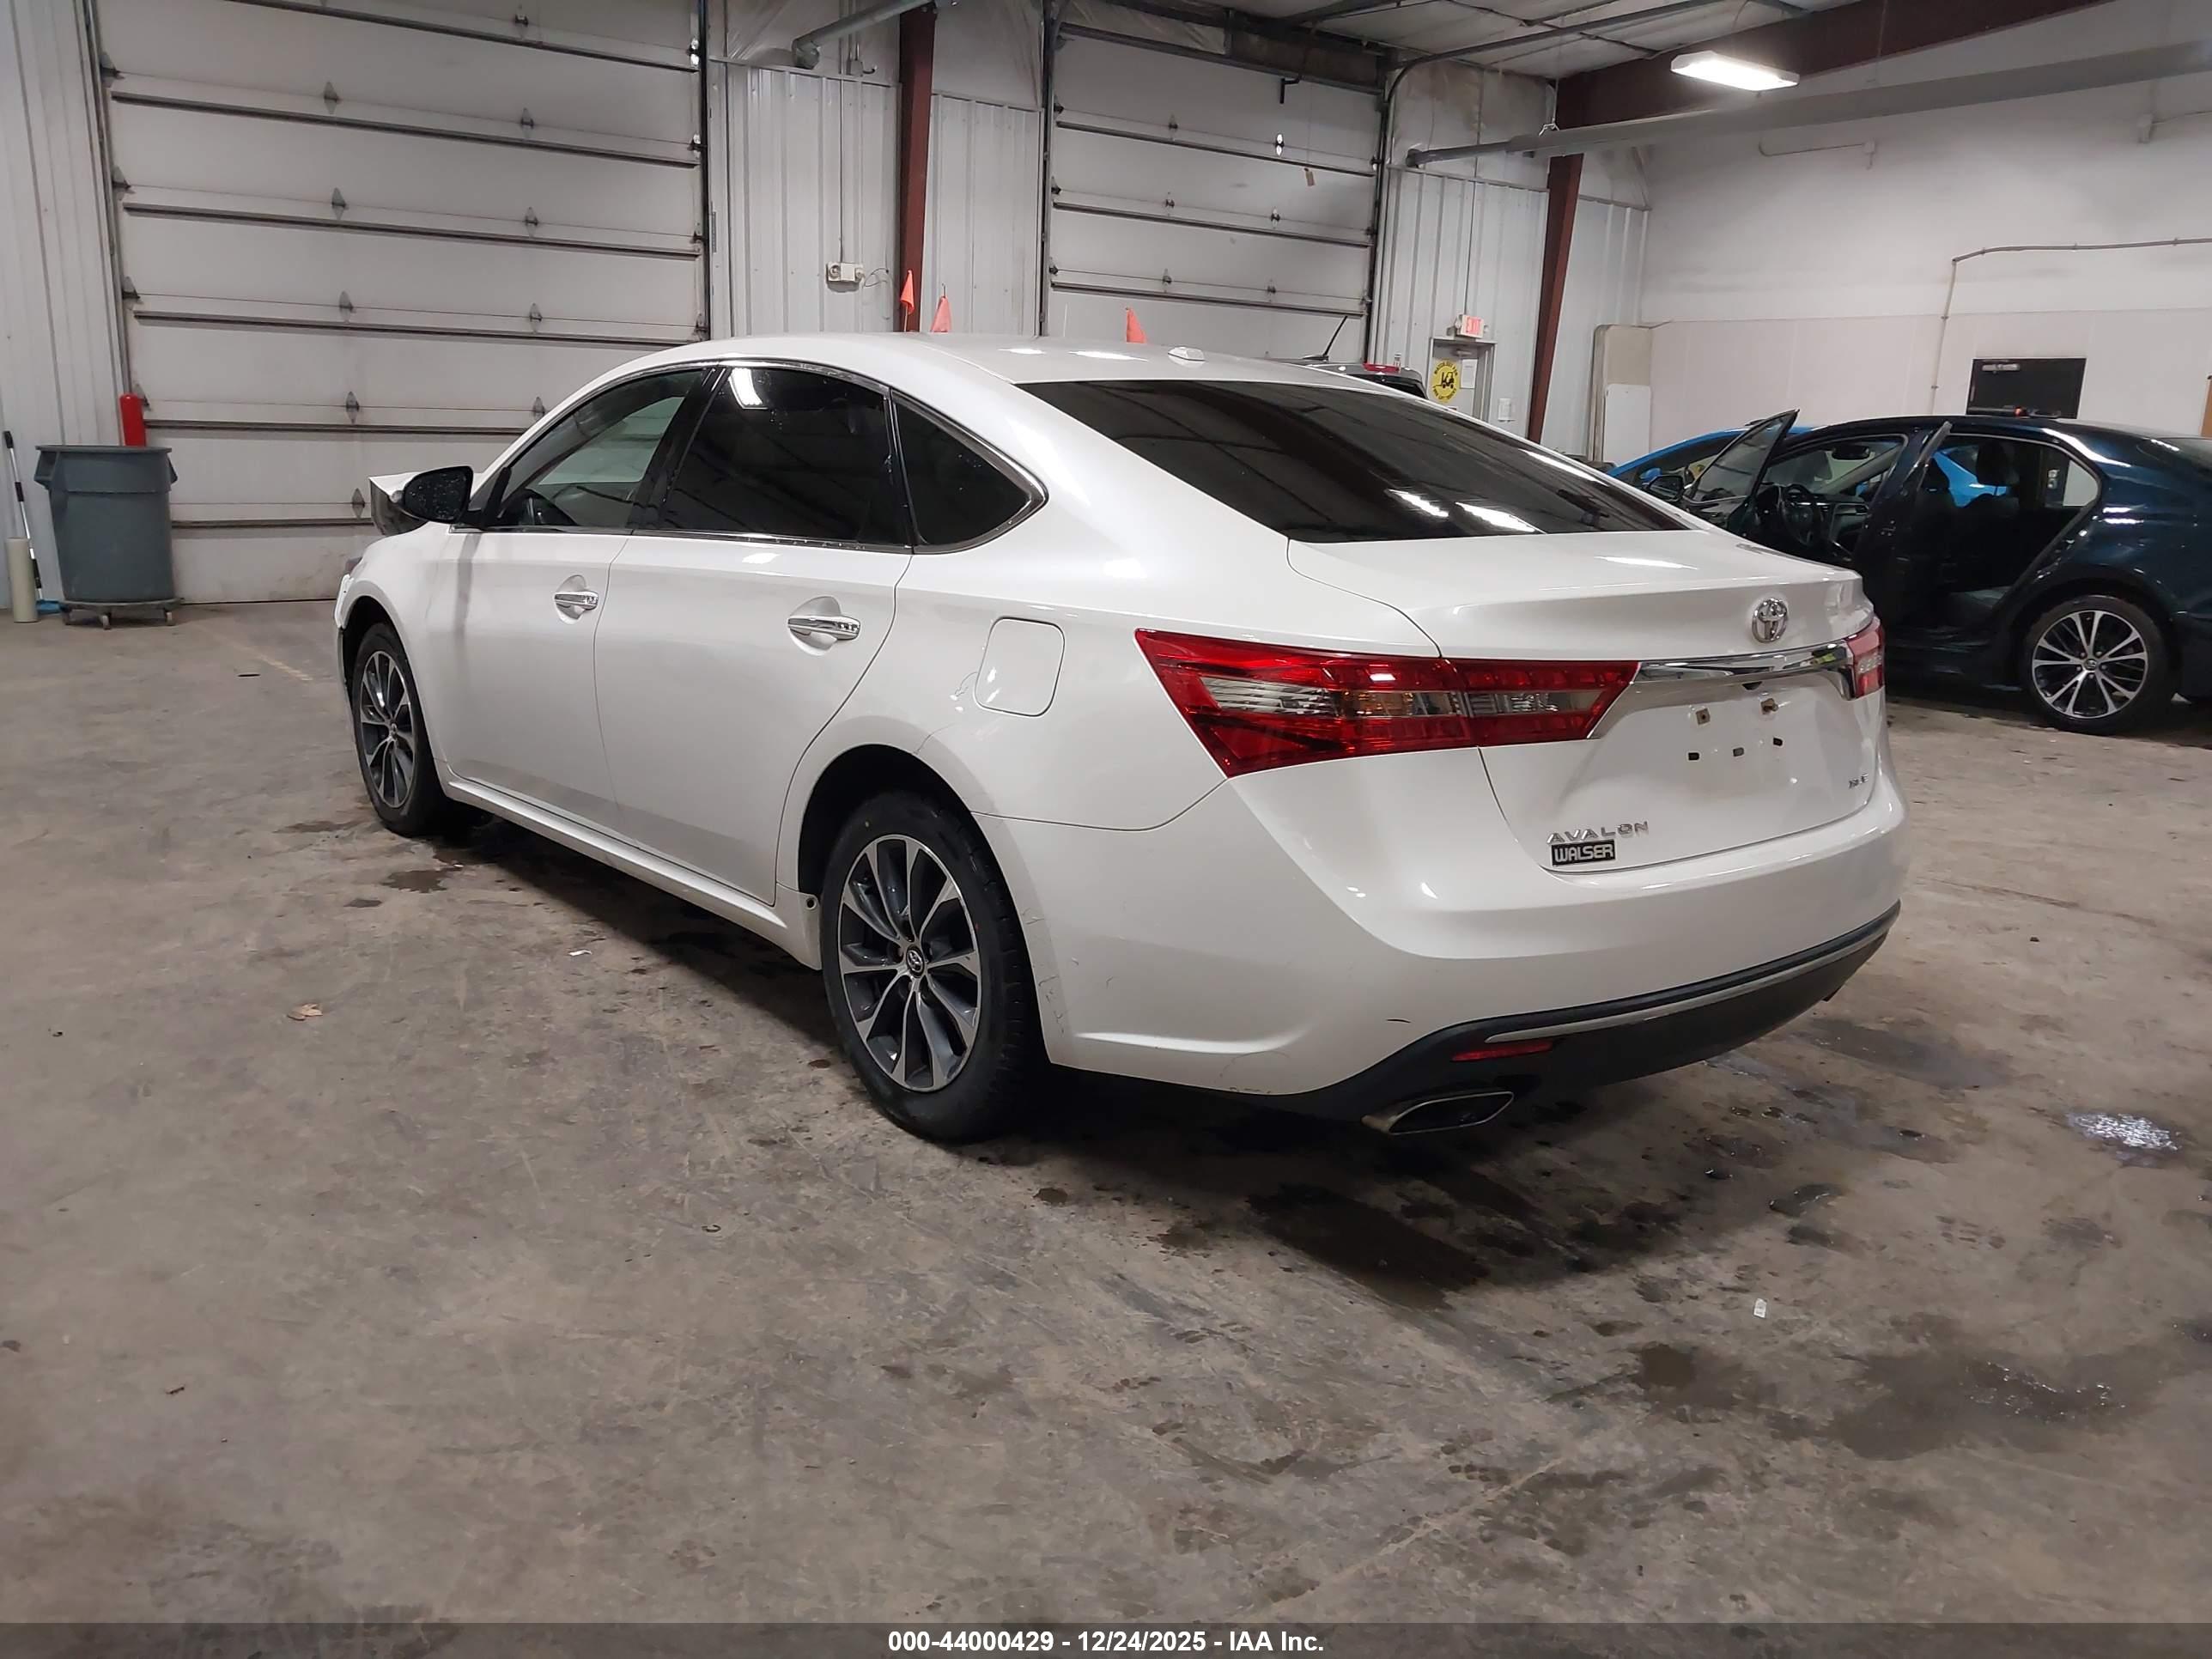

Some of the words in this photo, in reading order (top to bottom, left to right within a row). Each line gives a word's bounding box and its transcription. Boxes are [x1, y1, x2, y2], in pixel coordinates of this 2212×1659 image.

[1466, 316, 1482, 335] EXIT
[1547, 820, 1649, 844] AVALON
[1553, 843, 1614, 863] WALSER
